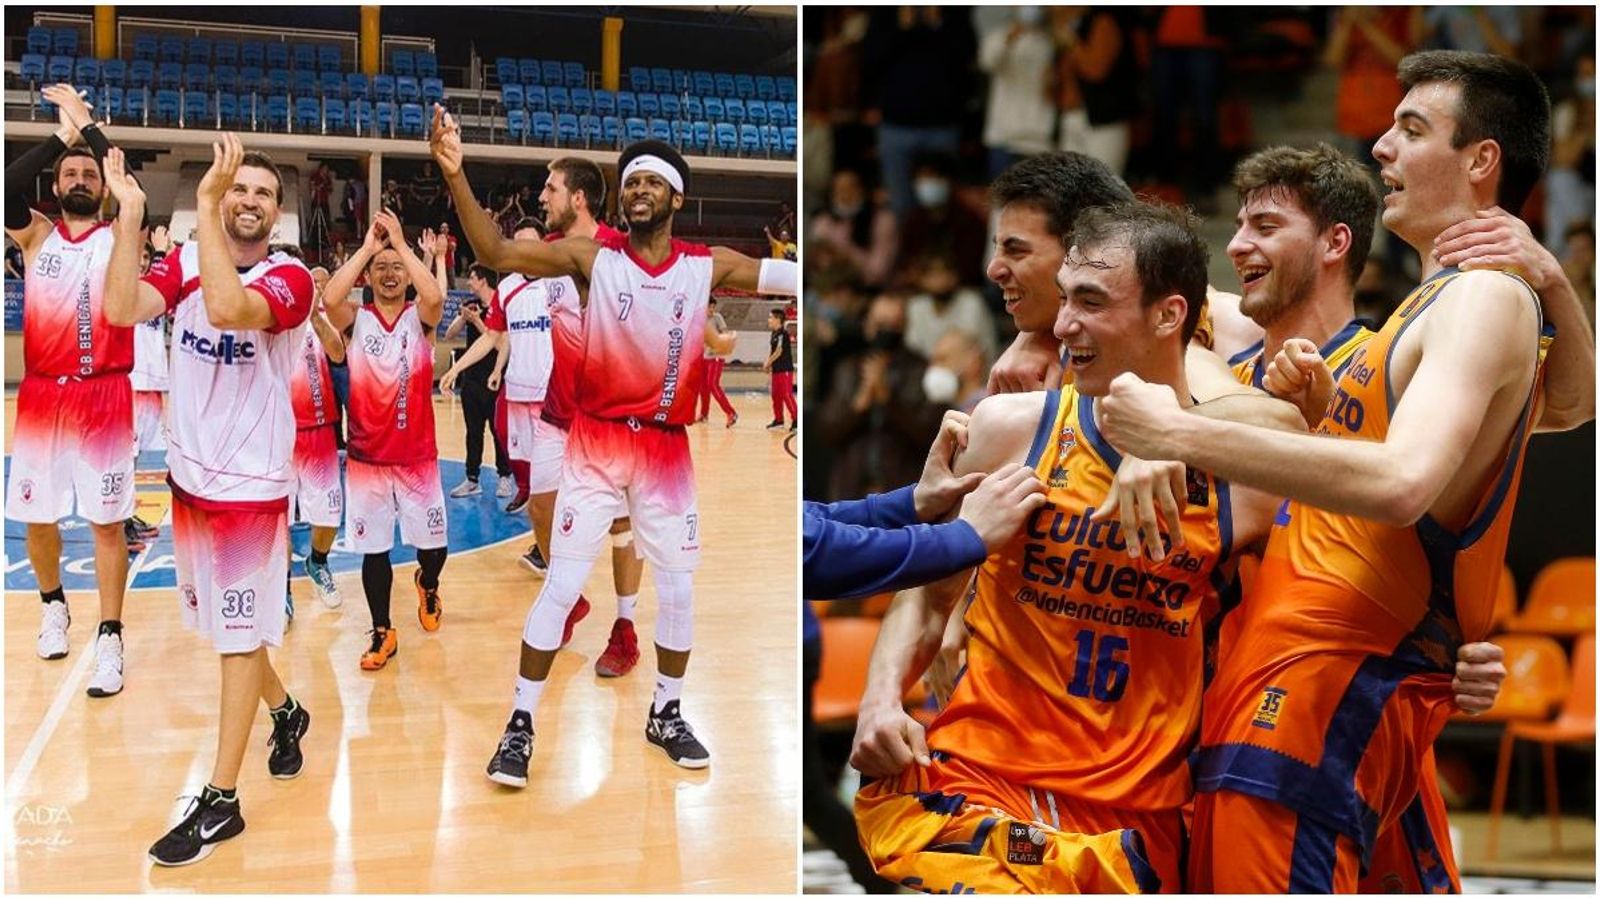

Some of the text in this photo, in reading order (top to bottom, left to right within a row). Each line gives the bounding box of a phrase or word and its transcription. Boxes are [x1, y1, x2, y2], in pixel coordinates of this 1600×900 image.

[618, 292, 634, 321] 7
[660, 327, 684, 407] BENICARLÓ
[102, 472, 125, 496] 35
[686, 513, 697, 541] 7
[1021, 543, 1191, 611] Esfuerzo
[1171, 551, 1205, 573] del
[222, 588, 256, 618] 38
[1014, 586, 1190, 638] @ValenciaBasket
[1066, 629, 1130, 704] 16
